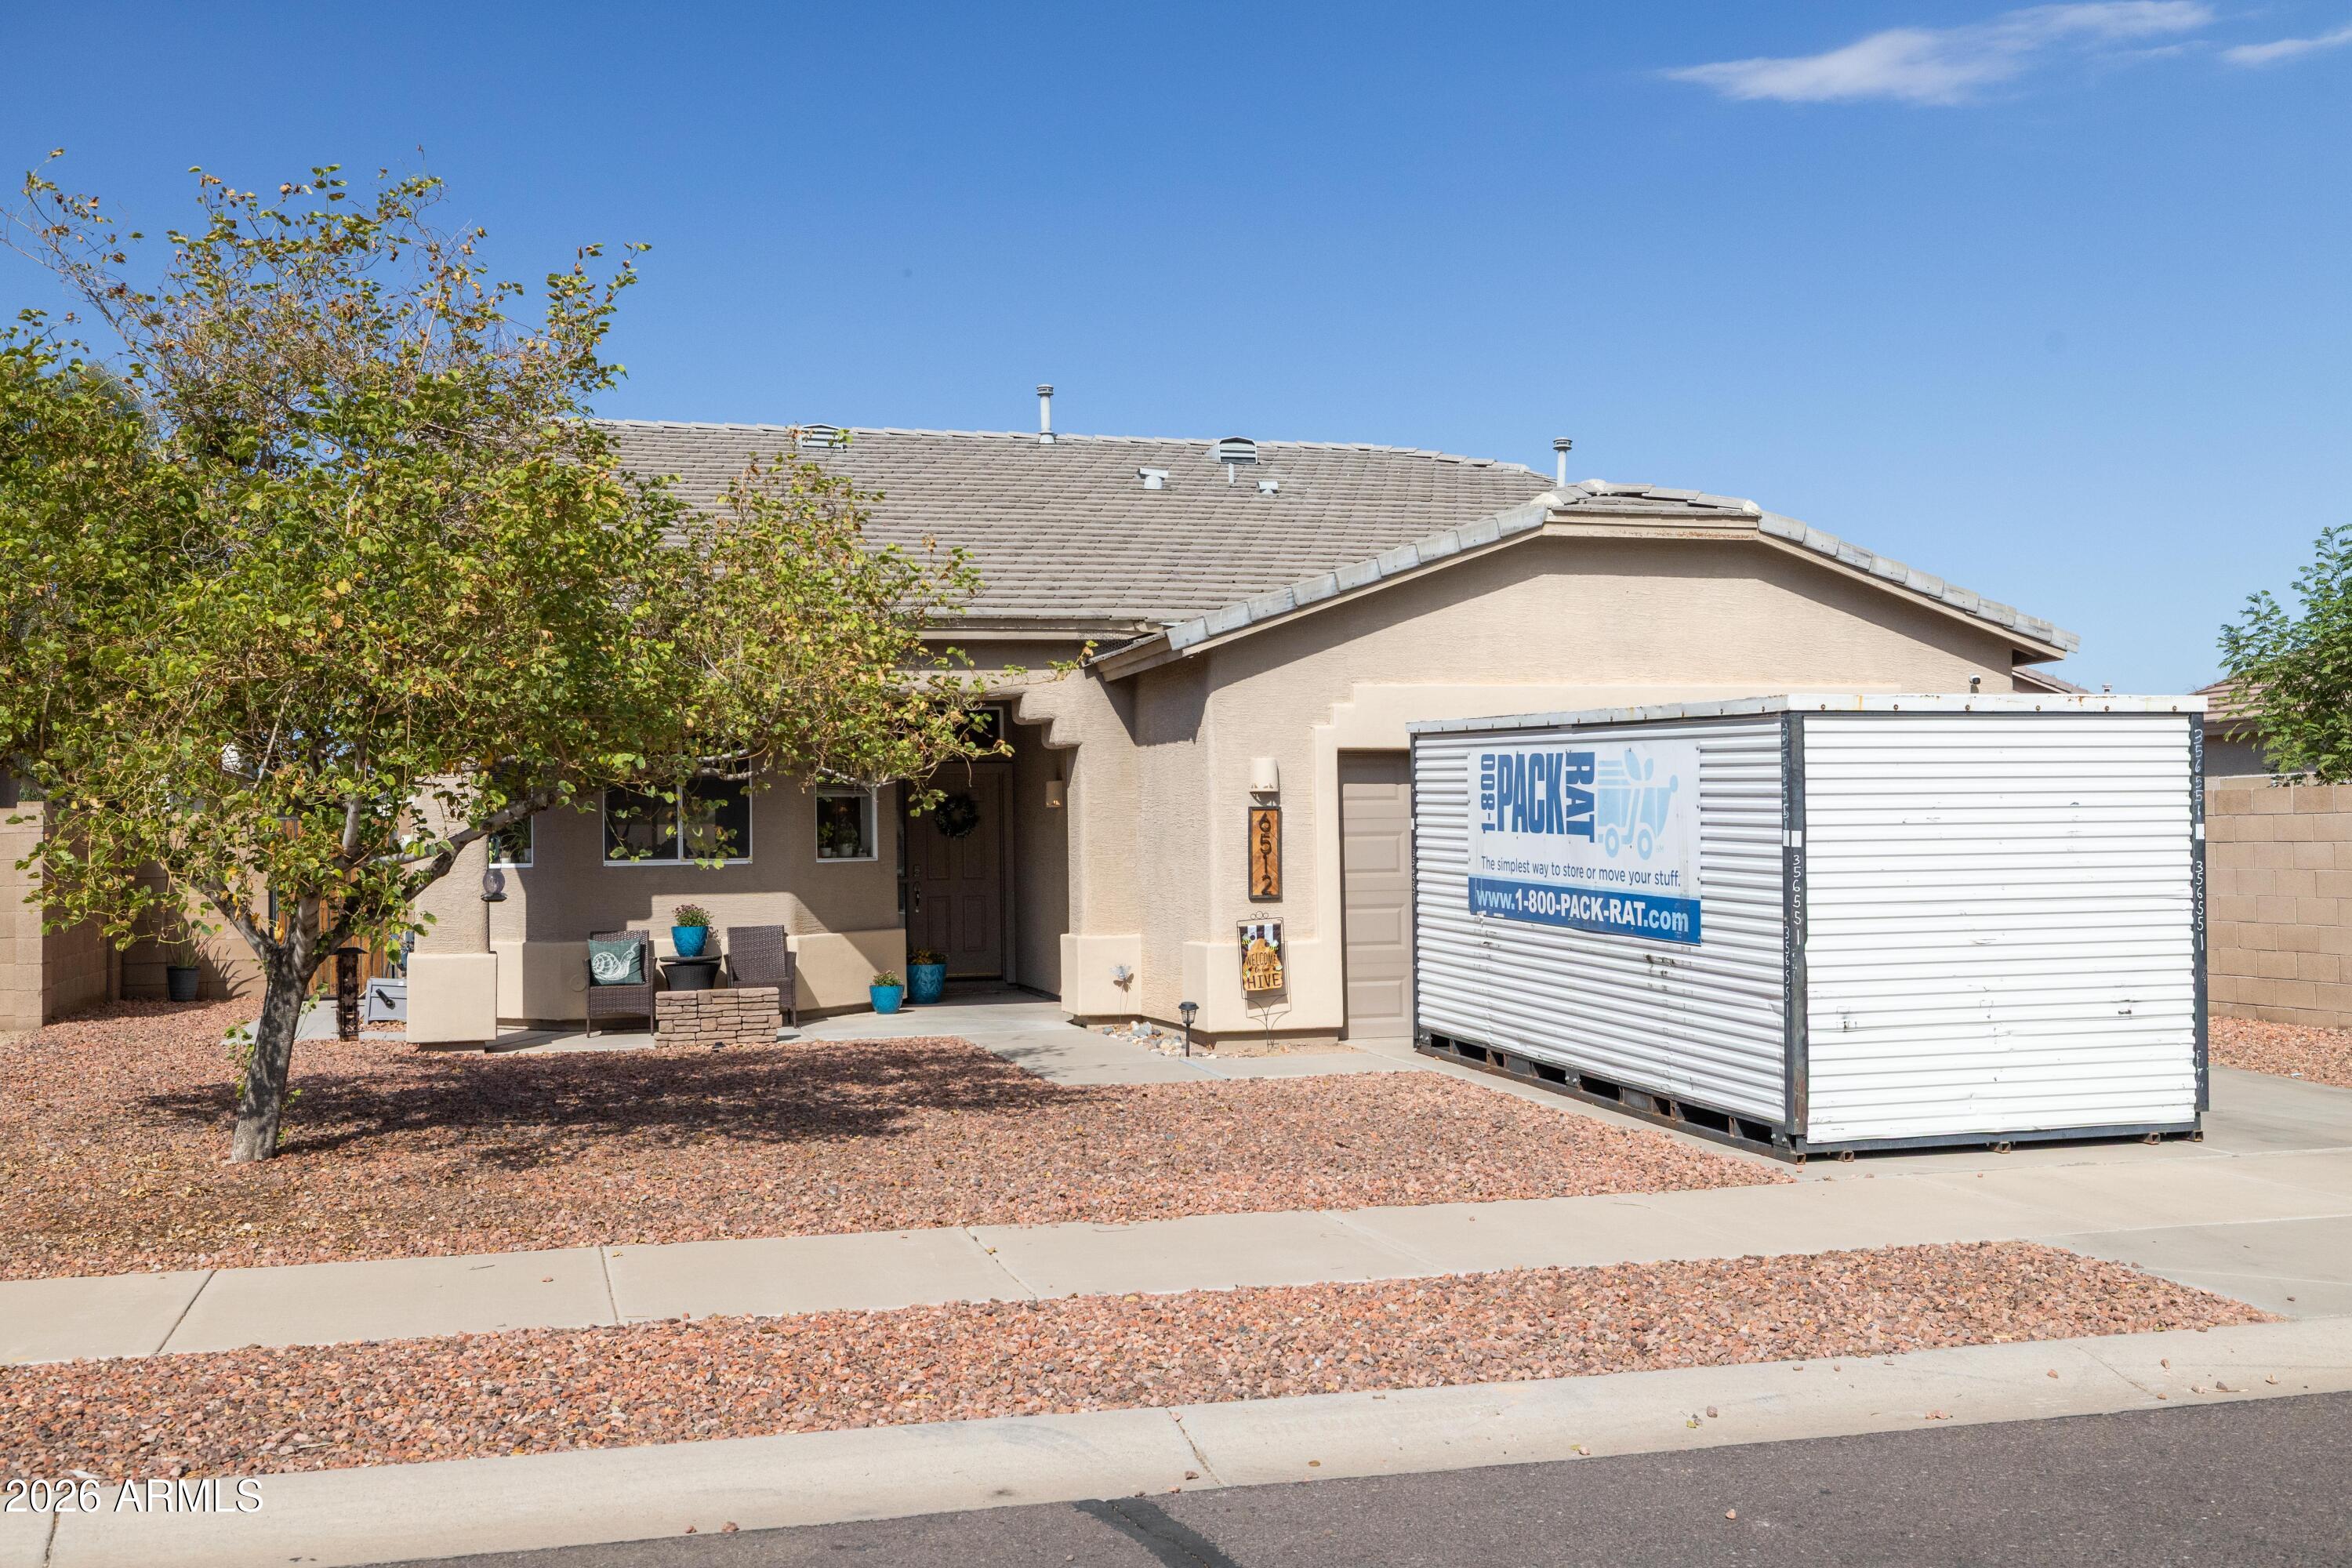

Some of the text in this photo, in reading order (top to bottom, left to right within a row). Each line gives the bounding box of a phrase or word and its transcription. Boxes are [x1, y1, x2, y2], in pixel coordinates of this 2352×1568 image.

[1481, 754, 1495, 833] 1-800
[1497, 753, 1565, 834] PACK
[1566, 752, 1595, 843] RAT
[2194, 729, 2202, 815] 356551
[1259, 812, 1272, 895] 6512
[1481, 855, 1681, 887] The simplest way to store or move your stuff.
[1475, 888, 1689, 932] www.1-800-PACK-RAT.com
[1793, 855, 1802, 946] 356551
[2194, 861, 2204, 950] 356551
[1247, 952, 1278, 965] WELCOME
[1247, 973, 1281, 989] HIVE
